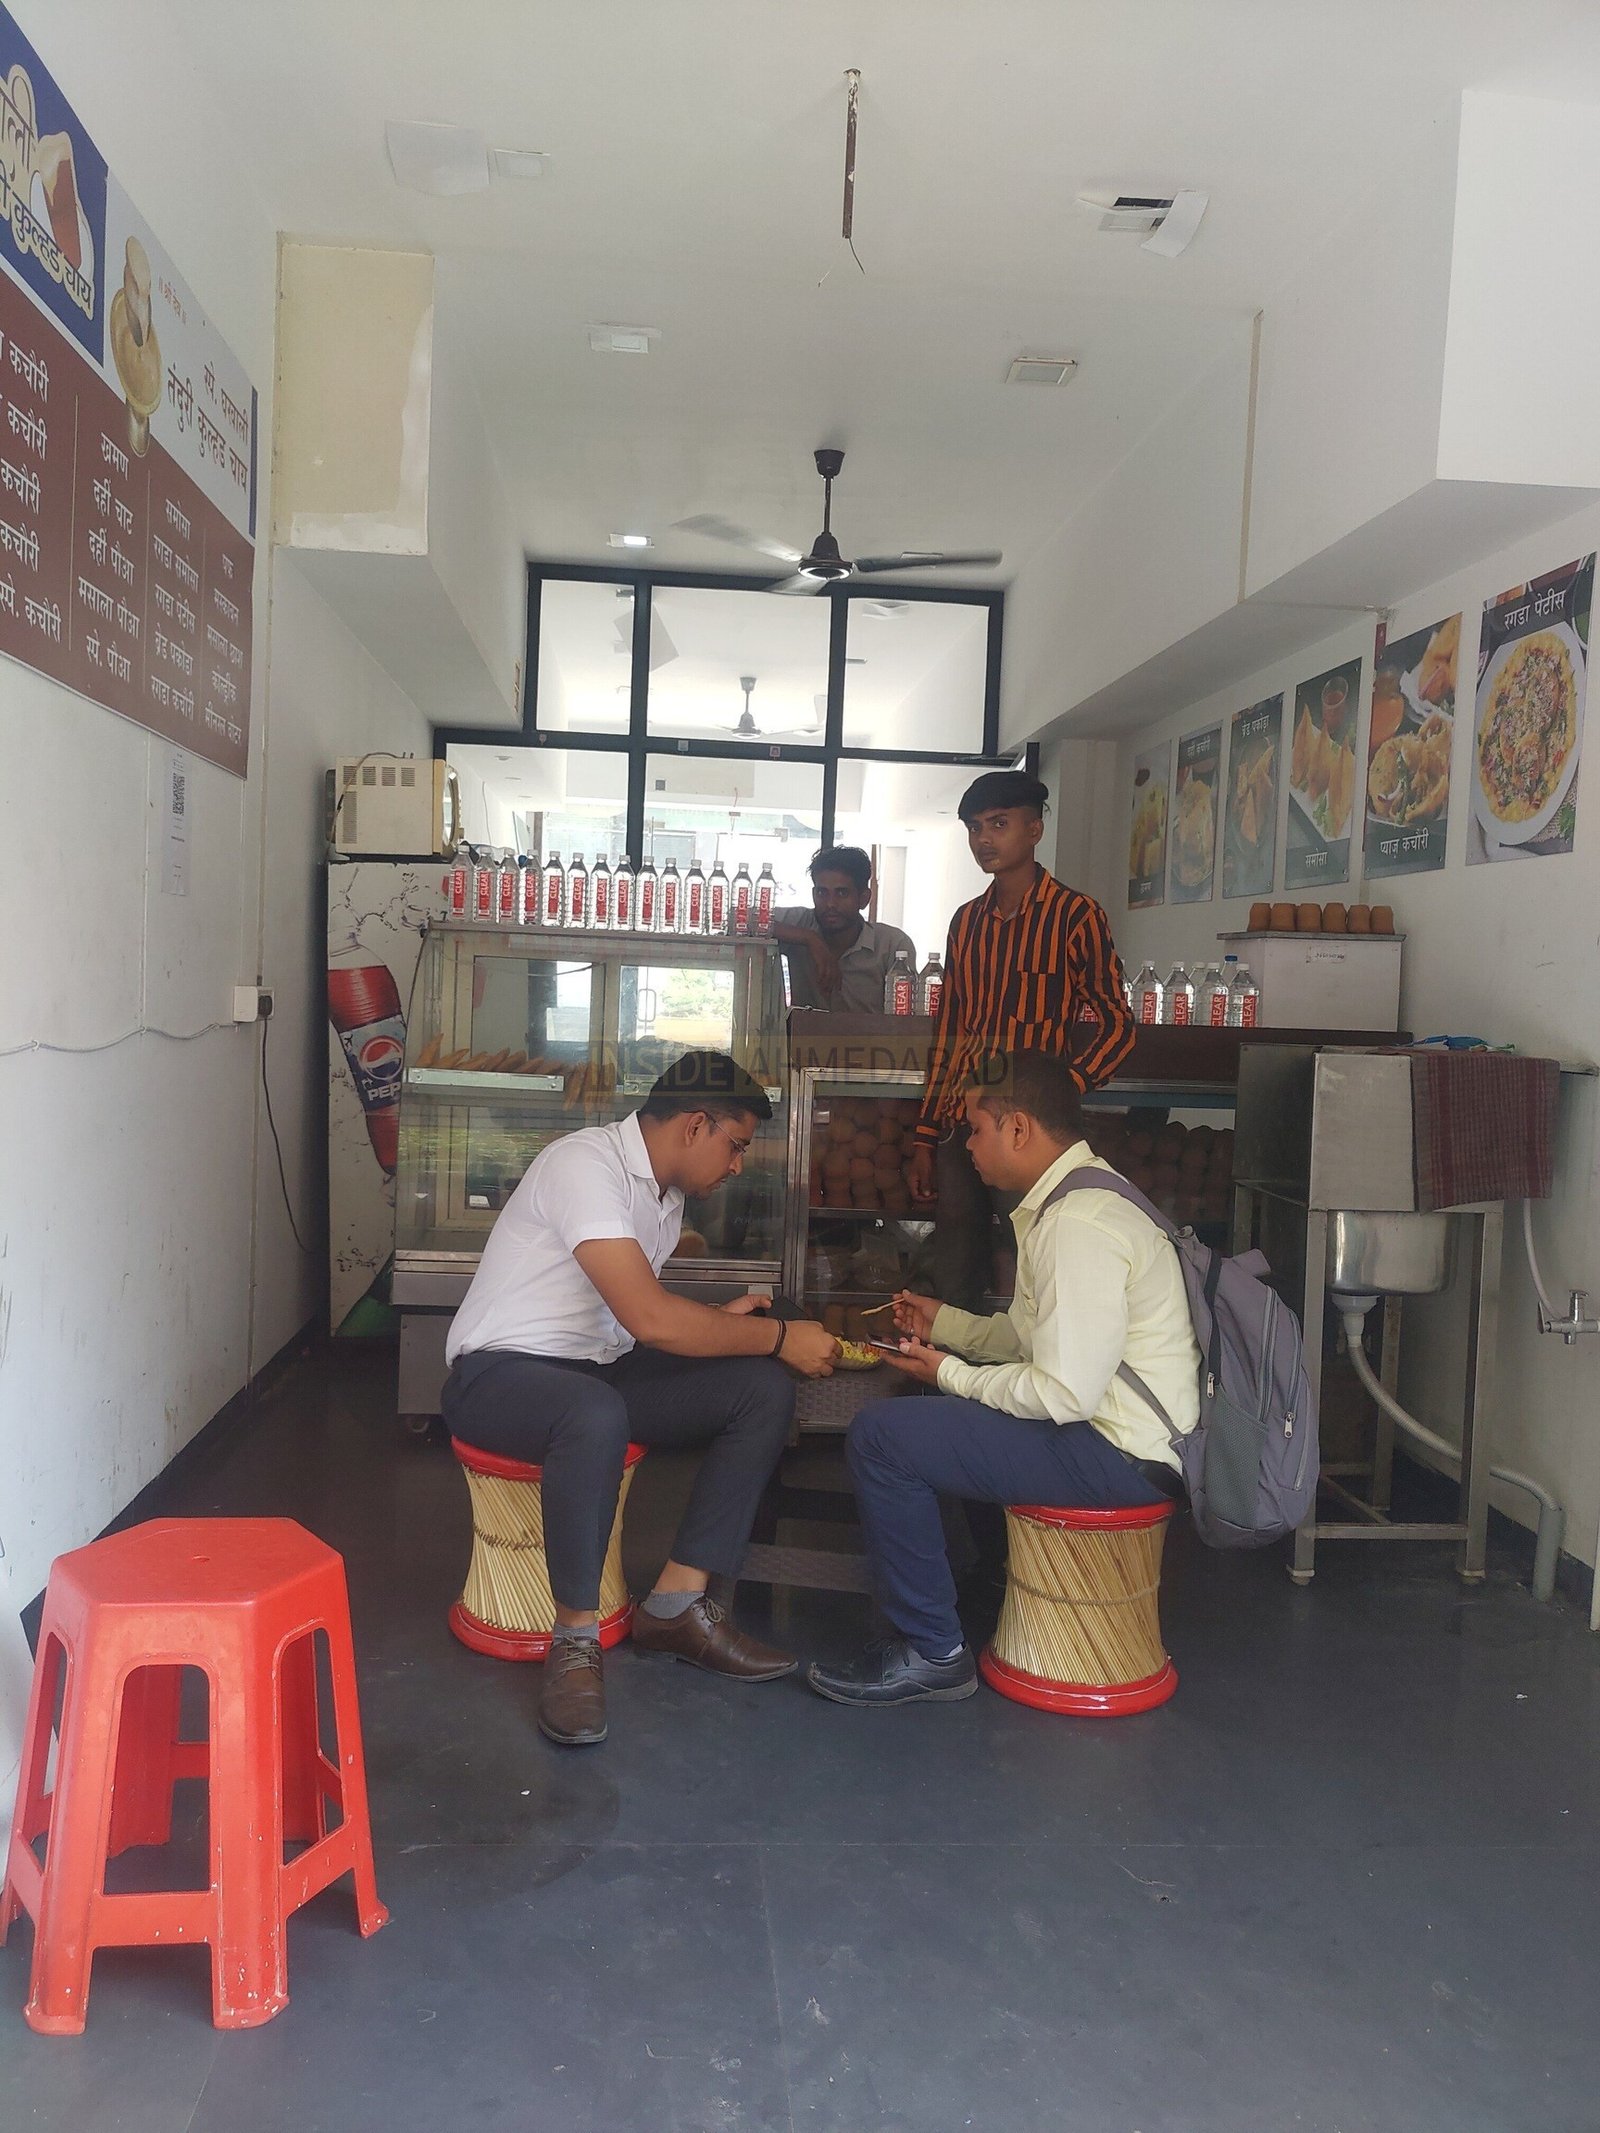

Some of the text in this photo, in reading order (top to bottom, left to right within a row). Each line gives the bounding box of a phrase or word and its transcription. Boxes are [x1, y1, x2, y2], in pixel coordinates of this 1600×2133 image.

[63, 253, 93, 313] चाय
[9, 339, 49, 403] कचौरी
[167, 362, 193, 433] तंदुरी
[8, 400, 47, 460] कचौरी
[101, 431, 129, 480] खमण
[0, 458, 41, 515] कचौरी
[115, 498, 133, 536] चाट
[166, 498, 190, 540] समोसा
[0, 520, 40, 572] कचौरी
[111, 540, 134, 585] पौआ
[175, 554, 199, 593] समोसा
[25, 596, 61, 642] कचौरी
[78, 576, 140, 640] मसाला पौआ
[1504, 588, 1566, 630] रगडा पेटीस
[107, 641, 130, 682] पौआ
[171, 687, 194, 721] कचौरी
[1402, 827, 1429, 852] कचौरी
[1305, 848, 1328, 869] समोसा
[454, 870, 464, 895] CLEAR
[480, 870, 490, 896] CLEAR
[502, 874, 512, 897] CLEAR
[526, 873, 535, 898] CLEAR
[549, 875, 560, 900] CLEAR
[573, 877, 583, 901] CLEAR
[596, 878, 606, 902] CLEAR
[619, 880, 629, 904] CLEAR
[643, 881, 653, 905] CLEAR
[667, 883, 676, 907] CLEAR
[691, 884, 700, 908] CLEAR
[713, 886, 722, 910] CLEAR
[738, 888, 747, 911] CLEAR
[760, 888, 770, 911] CLEAR
